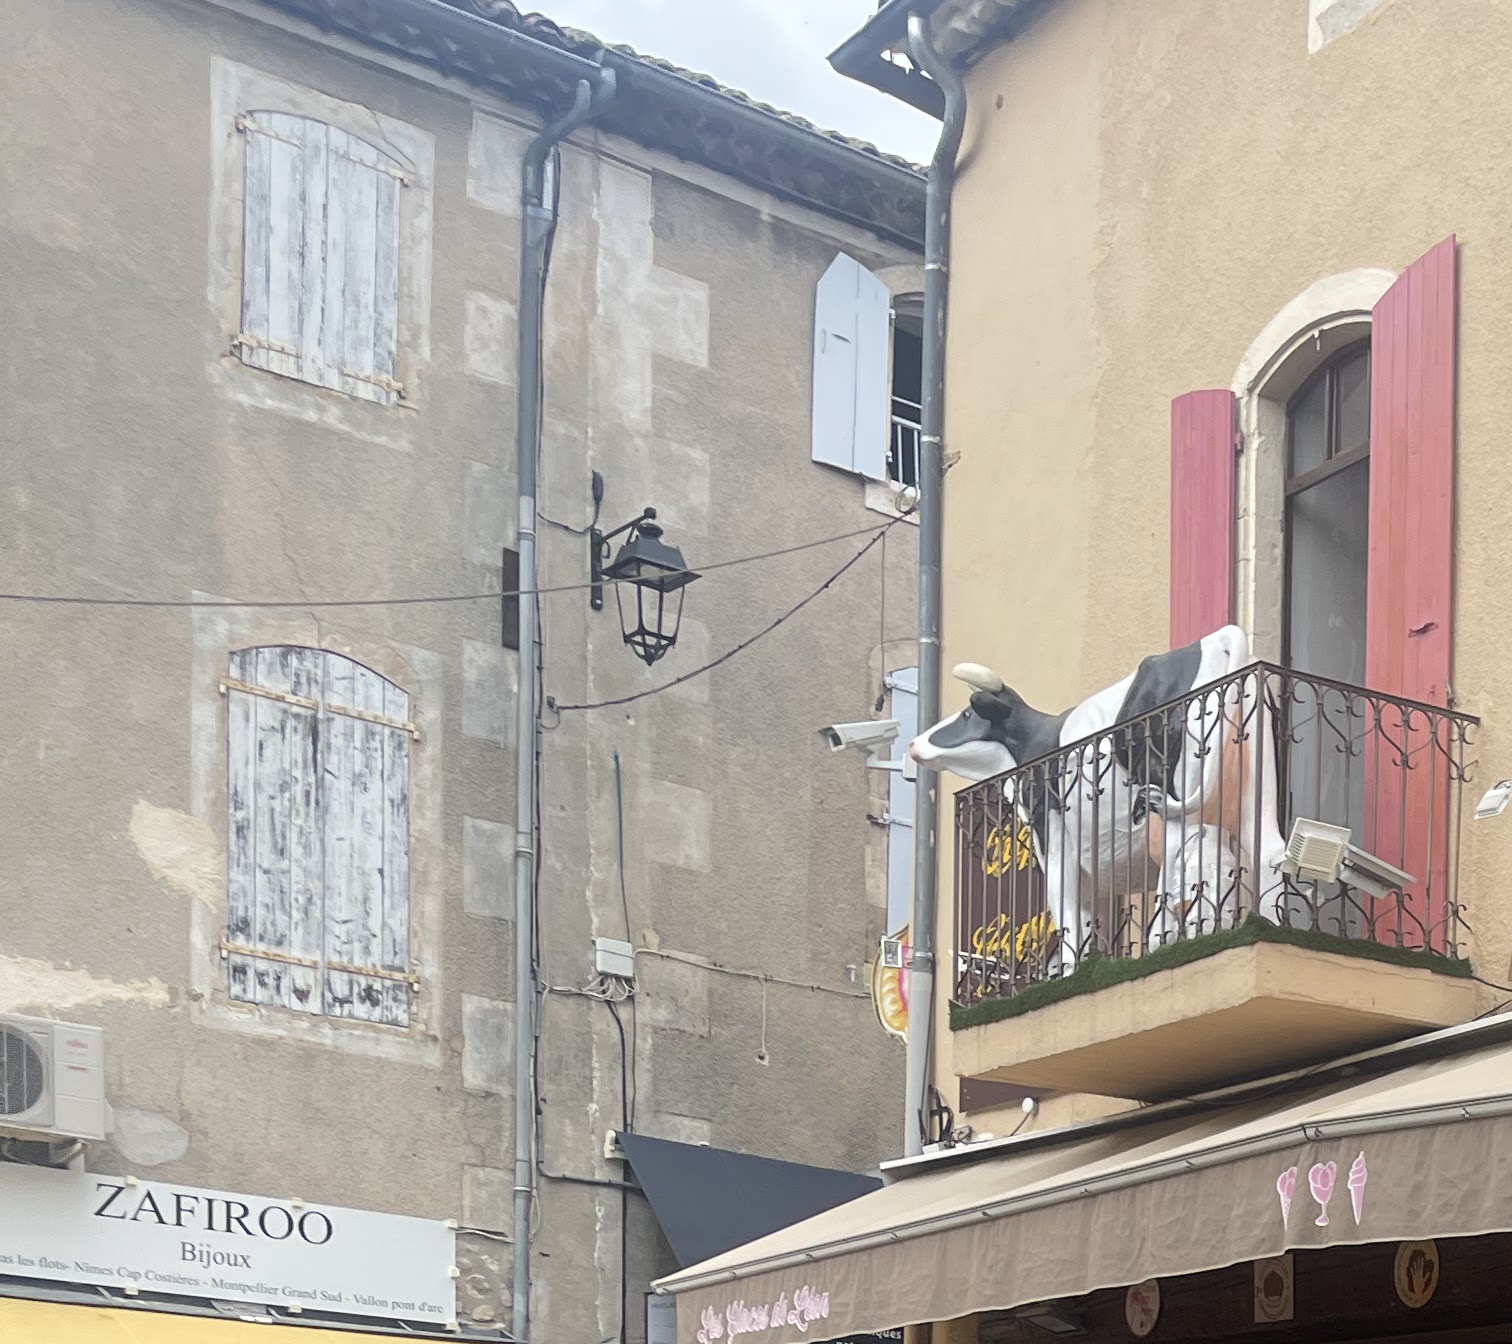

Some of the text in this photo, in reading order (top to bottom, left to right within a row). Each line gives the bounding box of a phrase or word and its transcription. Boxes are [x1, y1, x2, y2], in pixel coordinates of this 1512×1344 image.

[94, 1182, 333, 1245] ZAFIROO
[180, 1241, 252, 1270] Bijoux
[117, 1267, 141, 1282] Cap
[211, 1277, 278, 1297] Montpellier
[282, 1286, 317, 1301] Grand
[320, 1290, 342, 1303] Sud
[352, 1293, 388, 1308] Vallon
